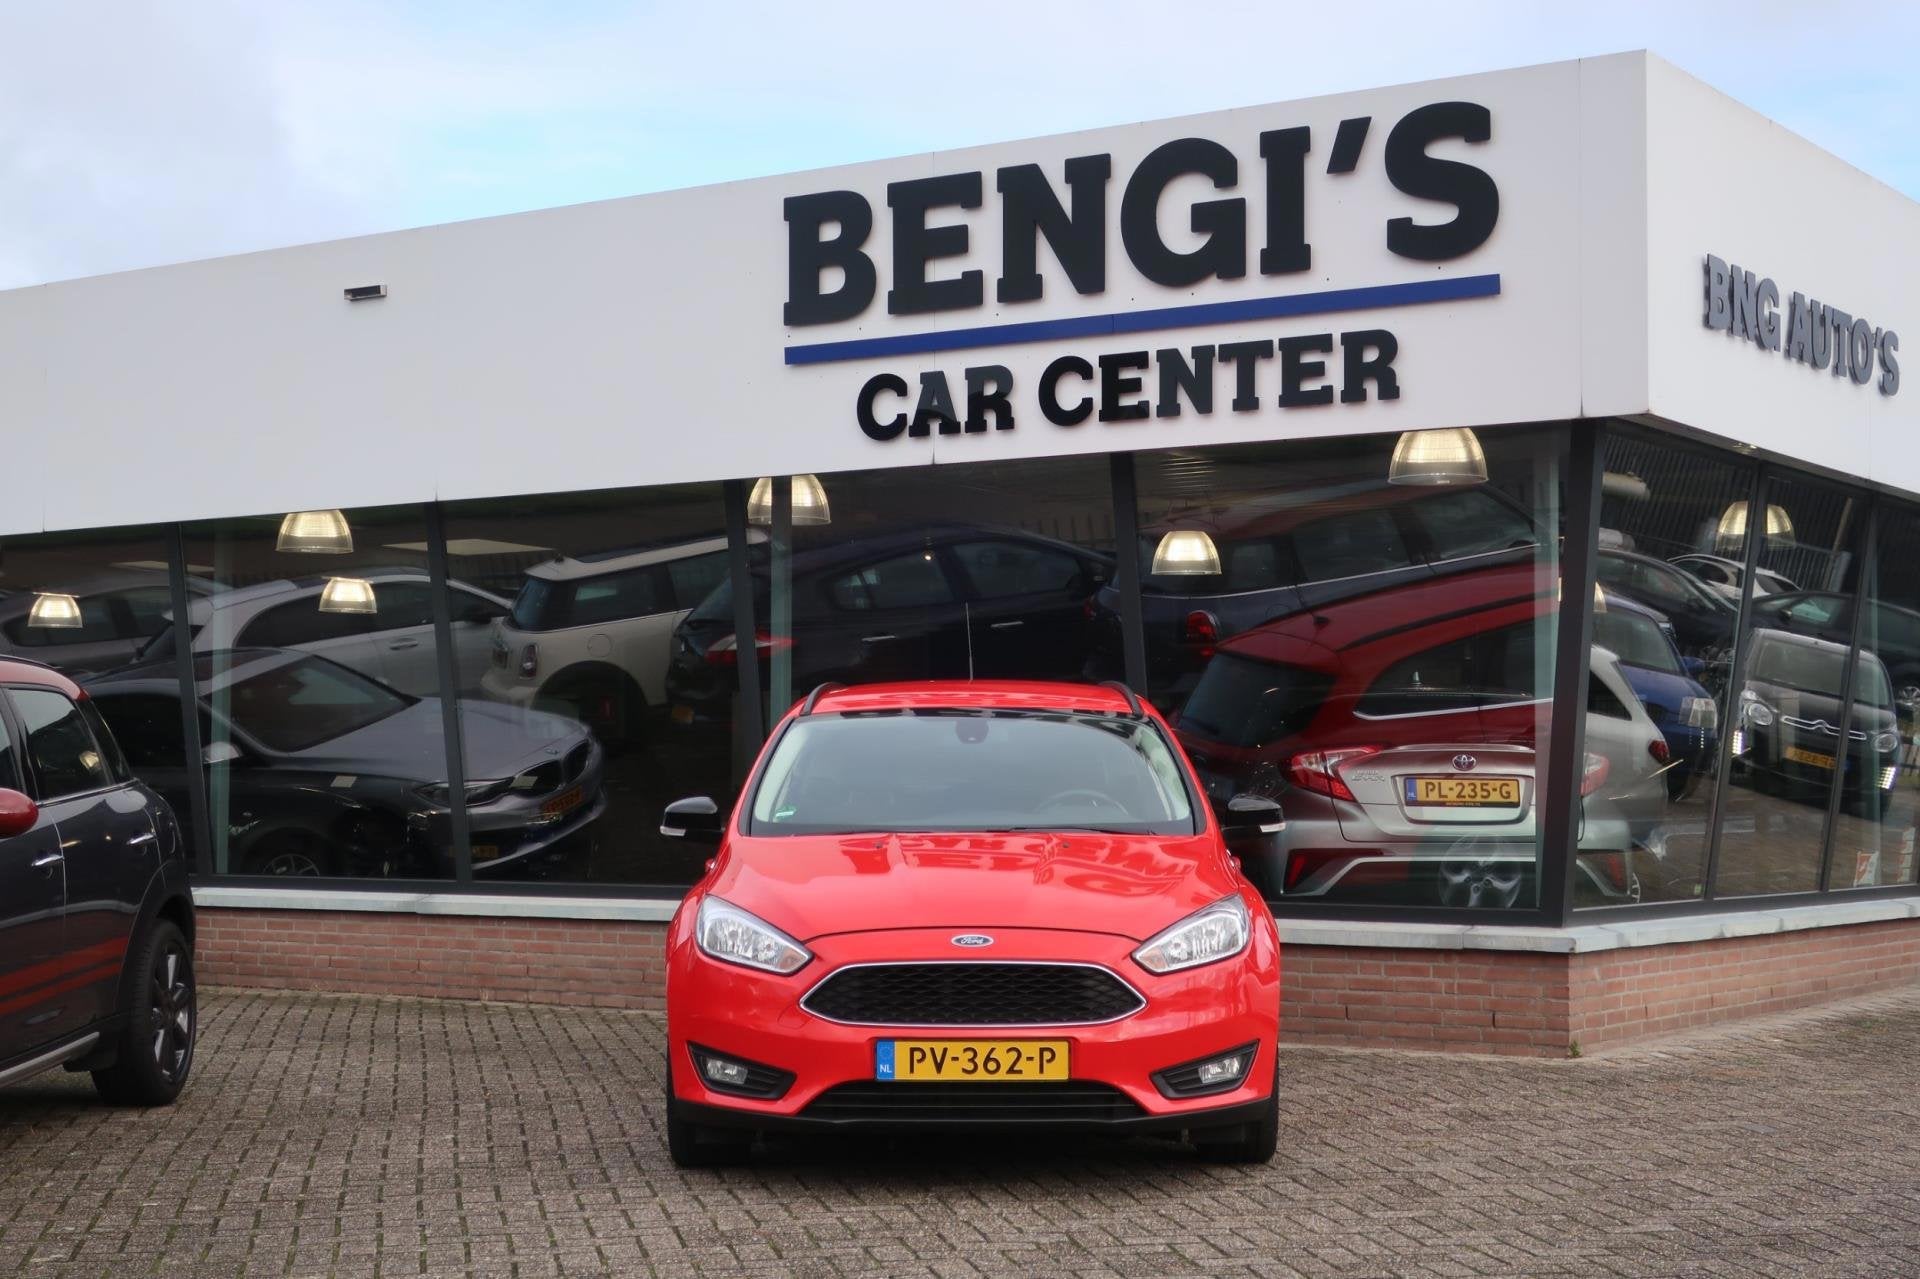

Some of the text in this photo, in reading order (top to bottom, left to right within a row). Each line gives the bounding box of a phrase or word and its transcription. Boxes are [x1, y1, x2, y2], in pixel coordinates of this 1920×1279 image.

[783, 101, 1500, 327] BENGI'S
[1705, 253, 1900, 396] BNG AUTO'S
[856, 328, 1401, 441] CAR CENTER
[1424, 781, 1512, 800] PL-235-G
[879, 1064, 892, 1073] NL
[909, 1046, 1057, 1076] PV-362-P
